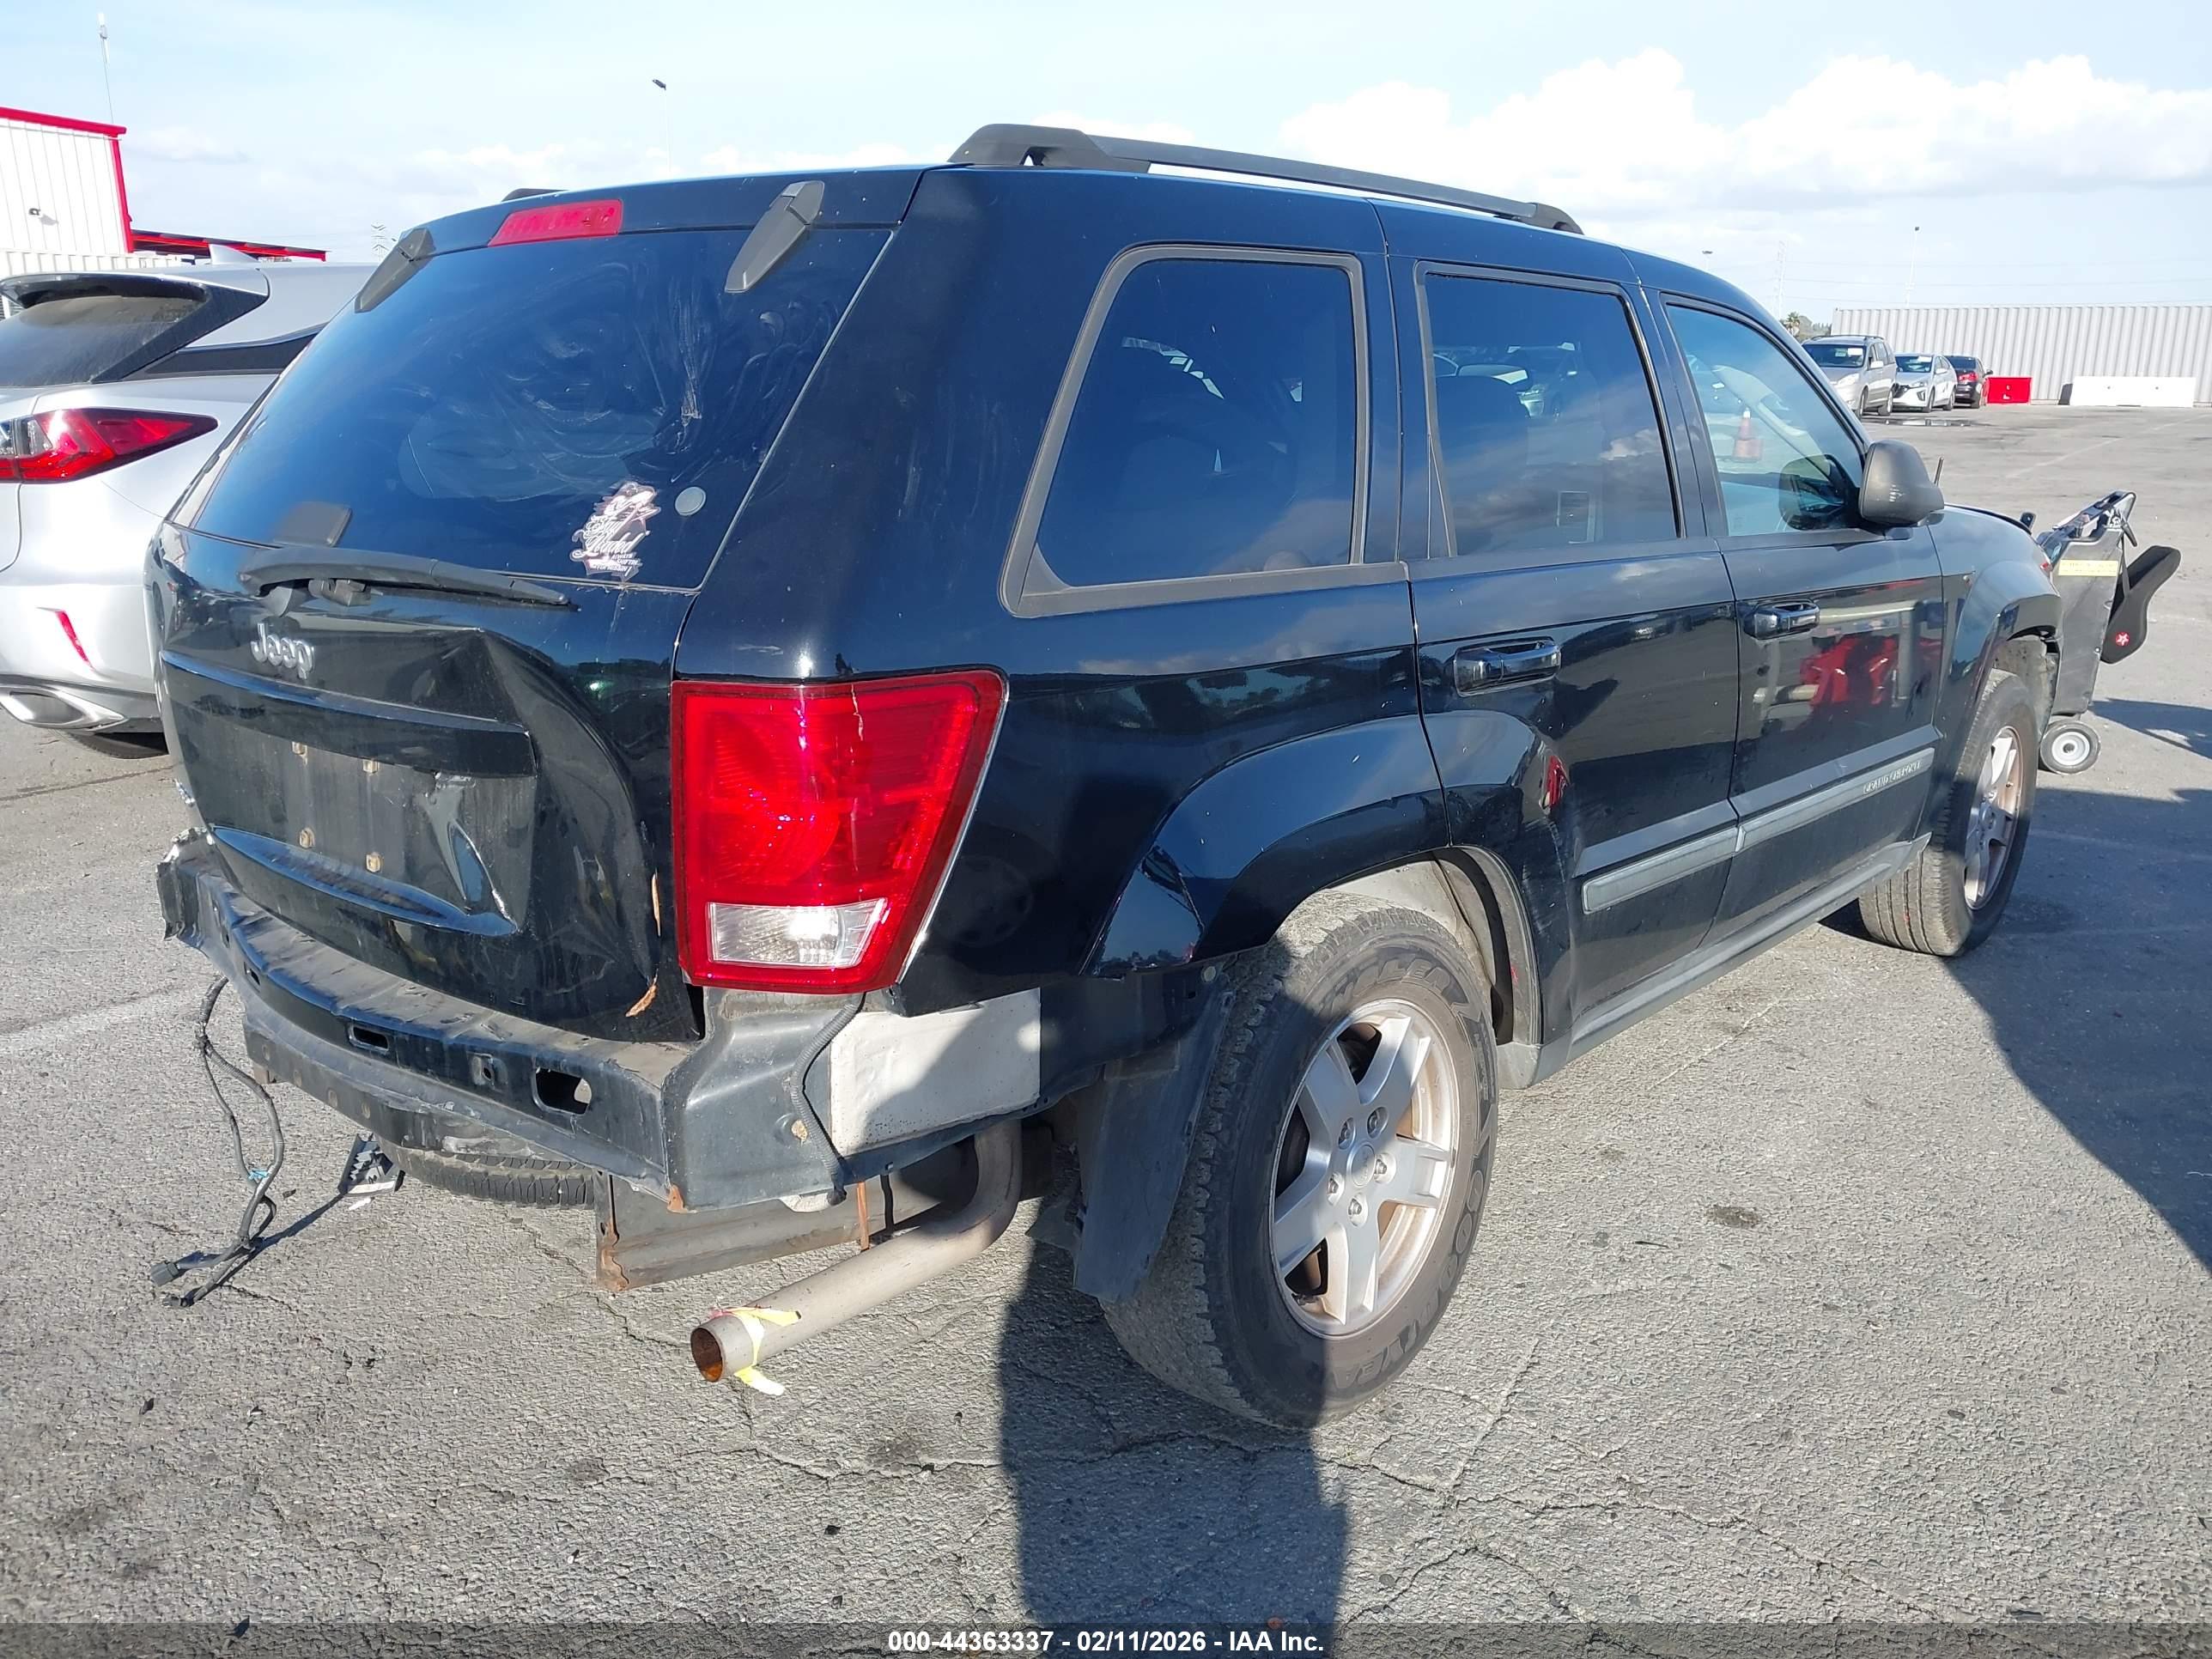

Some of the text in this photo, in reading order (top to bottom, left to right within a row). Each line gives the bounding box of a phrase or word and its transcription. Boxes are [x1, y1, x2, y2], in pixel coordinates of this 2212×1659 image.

[250, 623, 314, 679] Jeep
[1863, 775, 1889, 794] GRAND
[1331, 1169, 1484, 1389] GOODYEA
